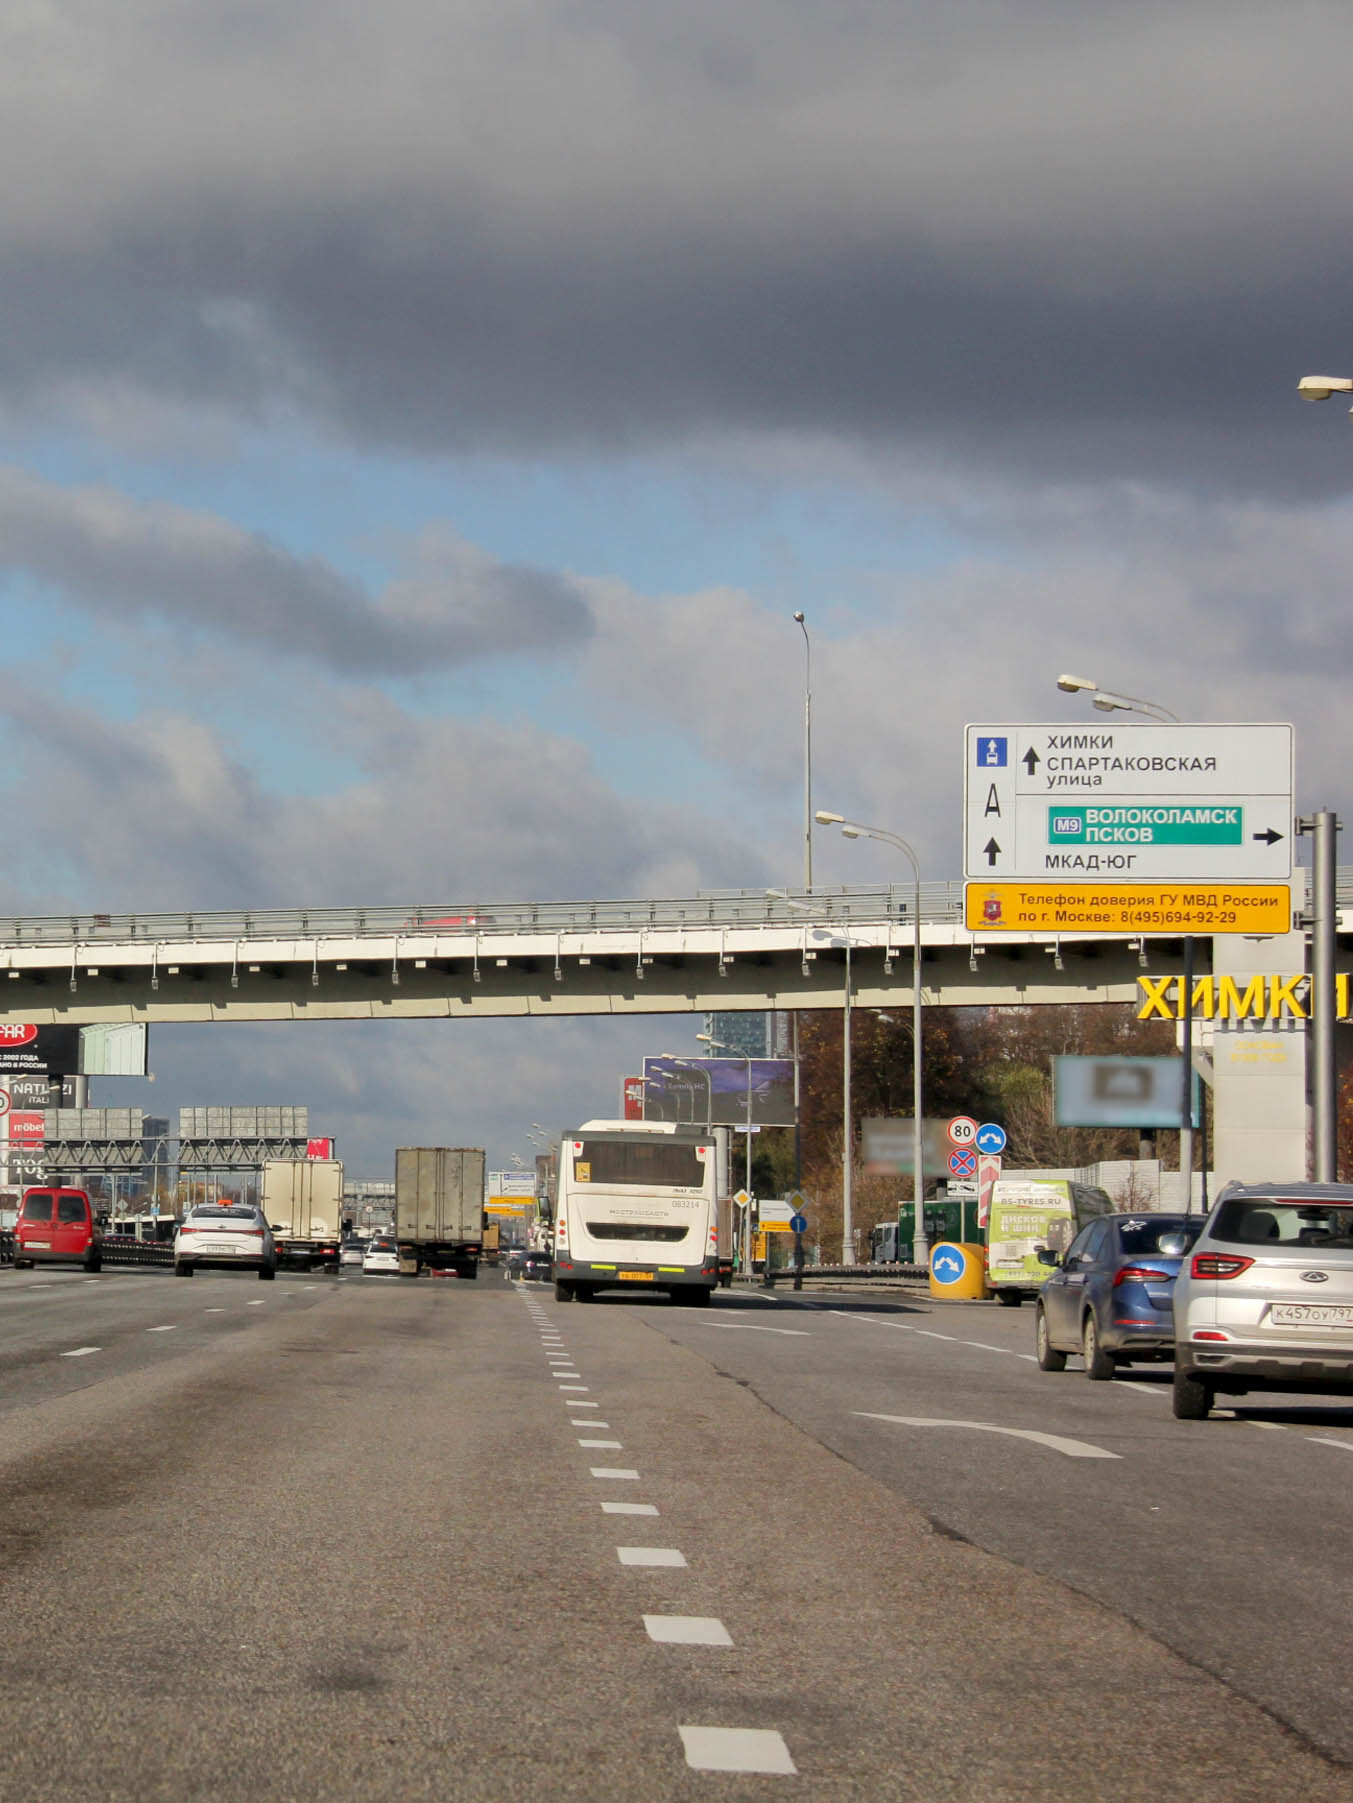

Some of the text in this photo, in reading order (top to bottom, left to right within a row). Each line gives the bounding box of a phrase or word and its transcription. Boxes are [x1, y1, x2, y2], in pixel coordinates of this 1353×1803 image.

[1048, 735, 1113, 749] ХИМКИ
[1046, 757, 1218, 772] СПАРТАКОВСКАЯ
[1046, 775, 1103, 789] улица
[984, 783, 1001, 818] А
[1086, 809, 1238, 824] ВОЛОКОЛАМСК
[1056, 819, 1079, 832] М9
[1086, 827, 1153, 842] ПСКОВ
[1045, 855, 1137, 871] МКАД-ЮГ
[1019, 893, 1279, 907] Телефон доверия ГУ МВД России
[1019, 910, 1237, 925] по г. Москве: 8(495)694-92-29
[20, 1054, 39, 1062] ГОДА
[13, 1083, 72, 1095] NATZI
[954, 1125, 971, 1137] 80
